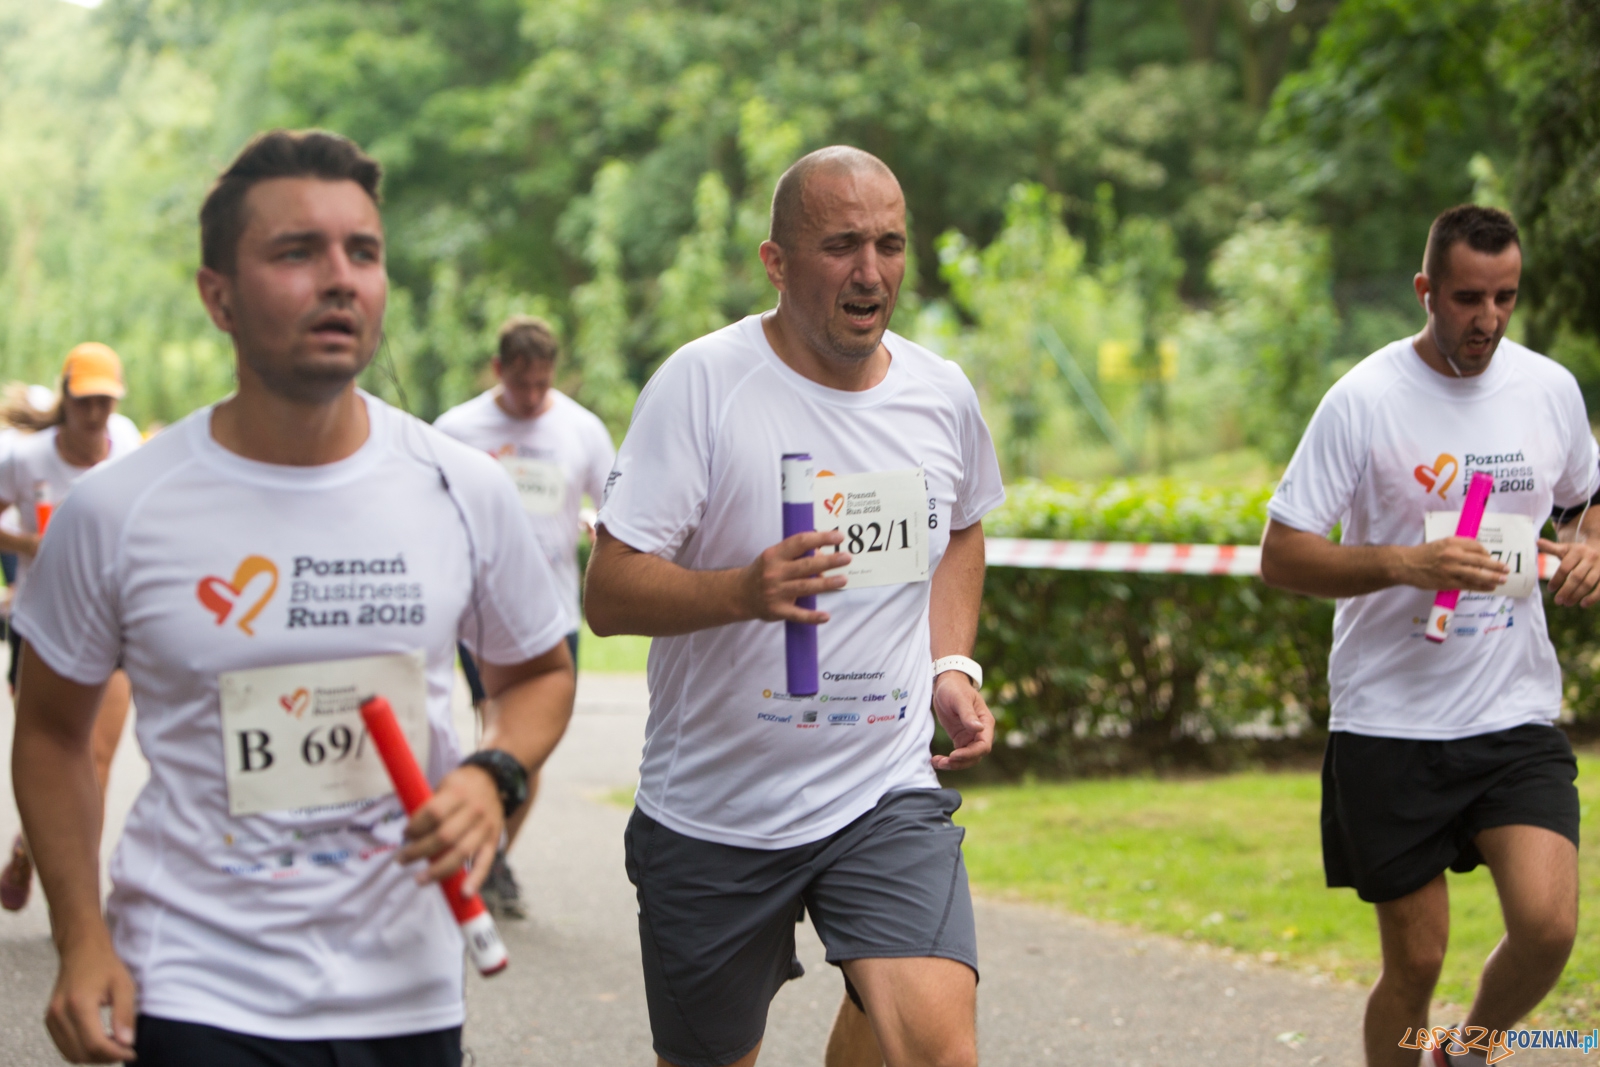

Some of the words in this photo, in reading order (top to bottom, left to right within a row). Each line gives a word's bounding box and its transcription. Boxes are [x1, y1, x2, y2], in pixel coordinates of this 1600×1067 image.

[1464, 449, 1525, 466] Poznań
[1464, 466, 1534, 482] Biness
[1499, 479, 1535, 493] 2016
[292, 552, 407, 578] Poznań
[290, 579, 423, 604] Business
[286, 606, 350, 629] Run
[356, 603, 426, 626] 2016
[862, 693, 888, 702] ciber
[237, 727, 275, 773] B
